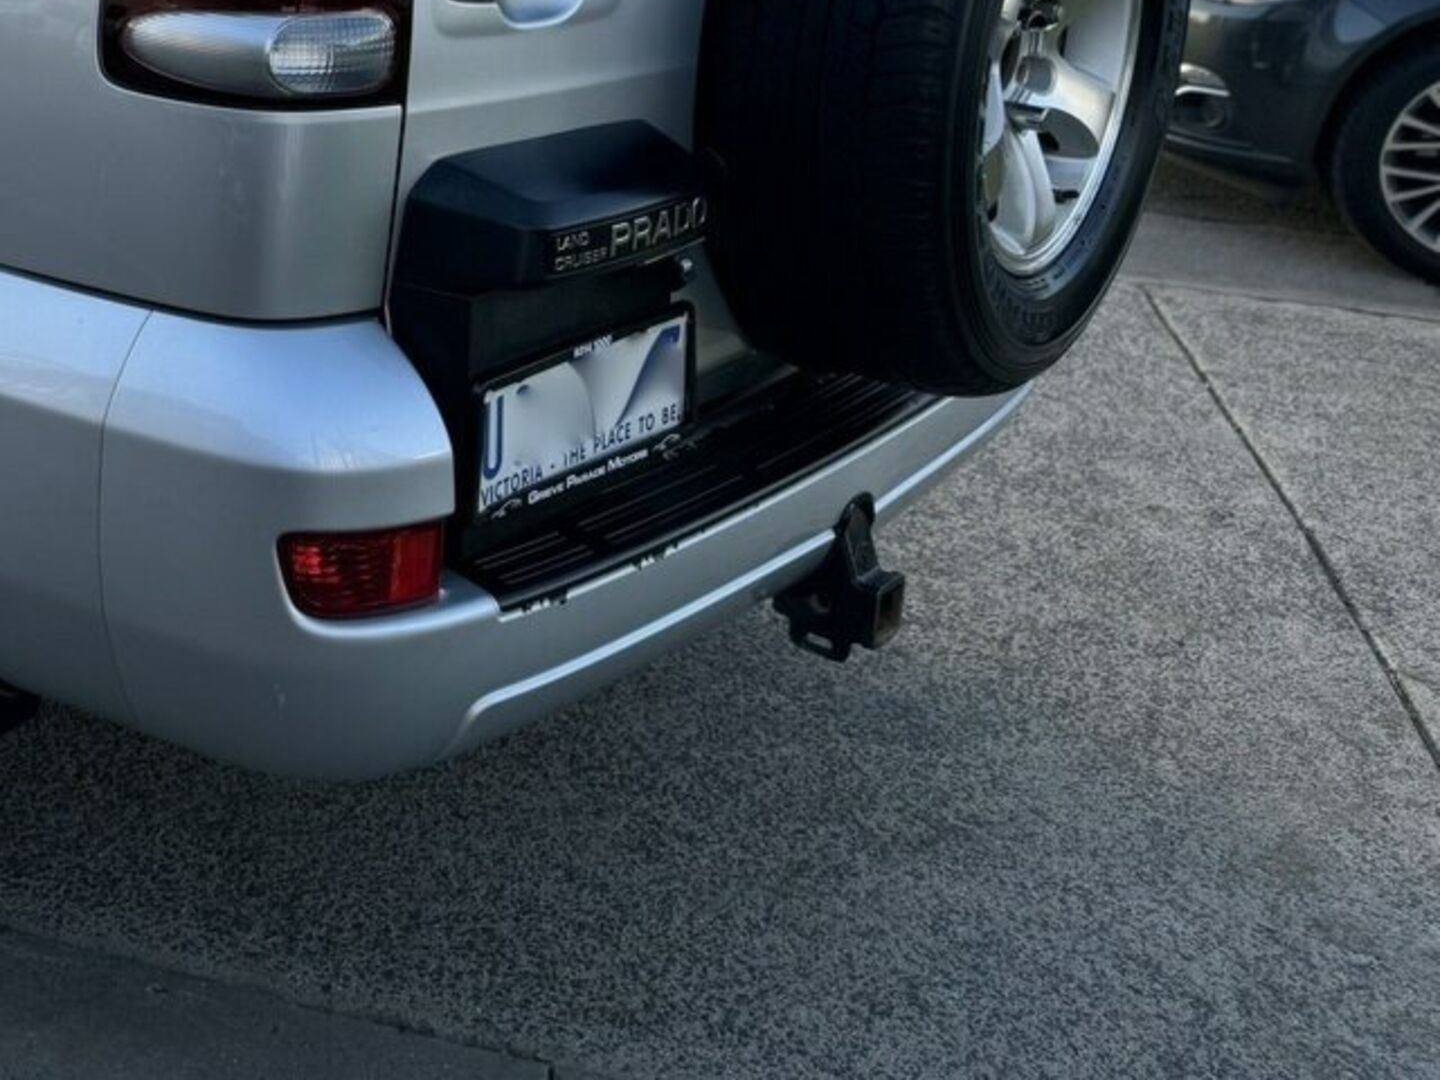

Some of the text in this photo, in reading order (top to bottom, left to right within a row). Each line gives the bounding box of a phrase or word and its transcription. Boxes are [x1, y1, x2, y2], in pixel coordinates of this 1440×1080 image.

[610, 197, 708, 258] PRADO
[480, 465, 543, 506] VICTORIA
[563, 443, 587, 469] THE
[593, 421, 632, 454] PLACE
[637, 411, 656, 433] TO
